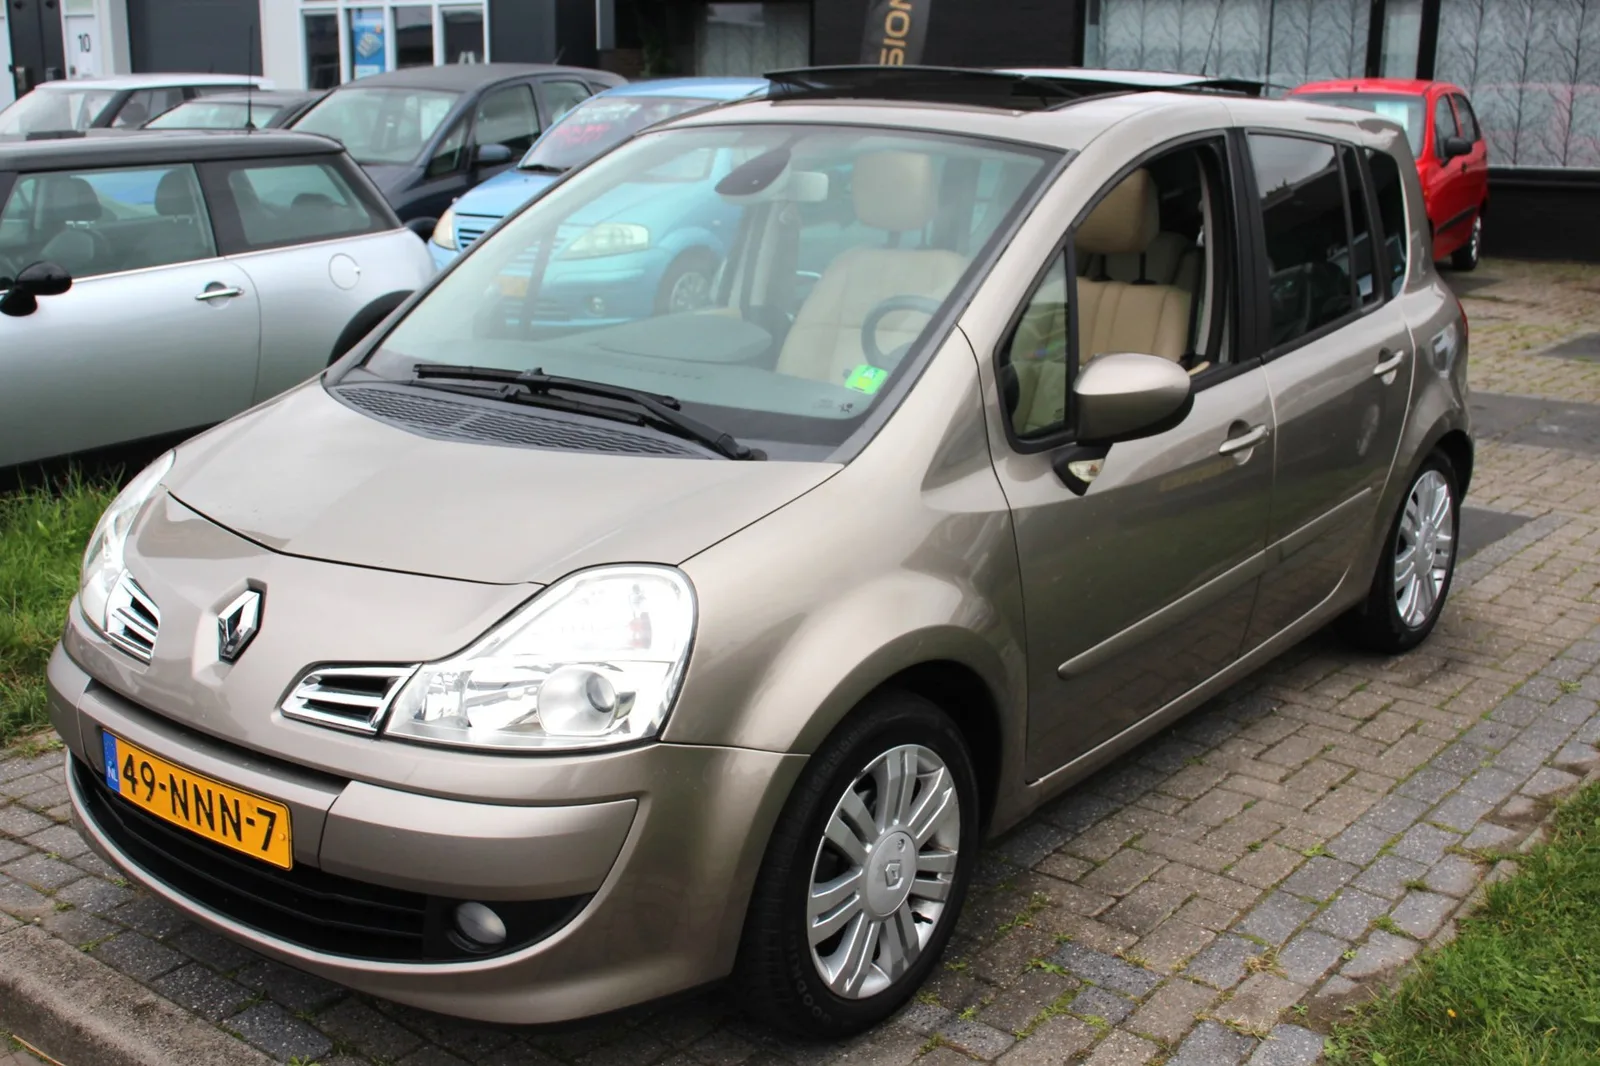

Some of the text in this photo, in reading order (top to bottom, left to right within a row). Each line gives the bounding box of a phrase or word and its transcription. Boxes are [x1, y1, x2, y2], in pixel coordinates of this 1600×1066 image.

[78, 33, 91, 52] 10
[107, 766, 118, 782] NL
[123, 753, 277, 851] 49-NNN-7
